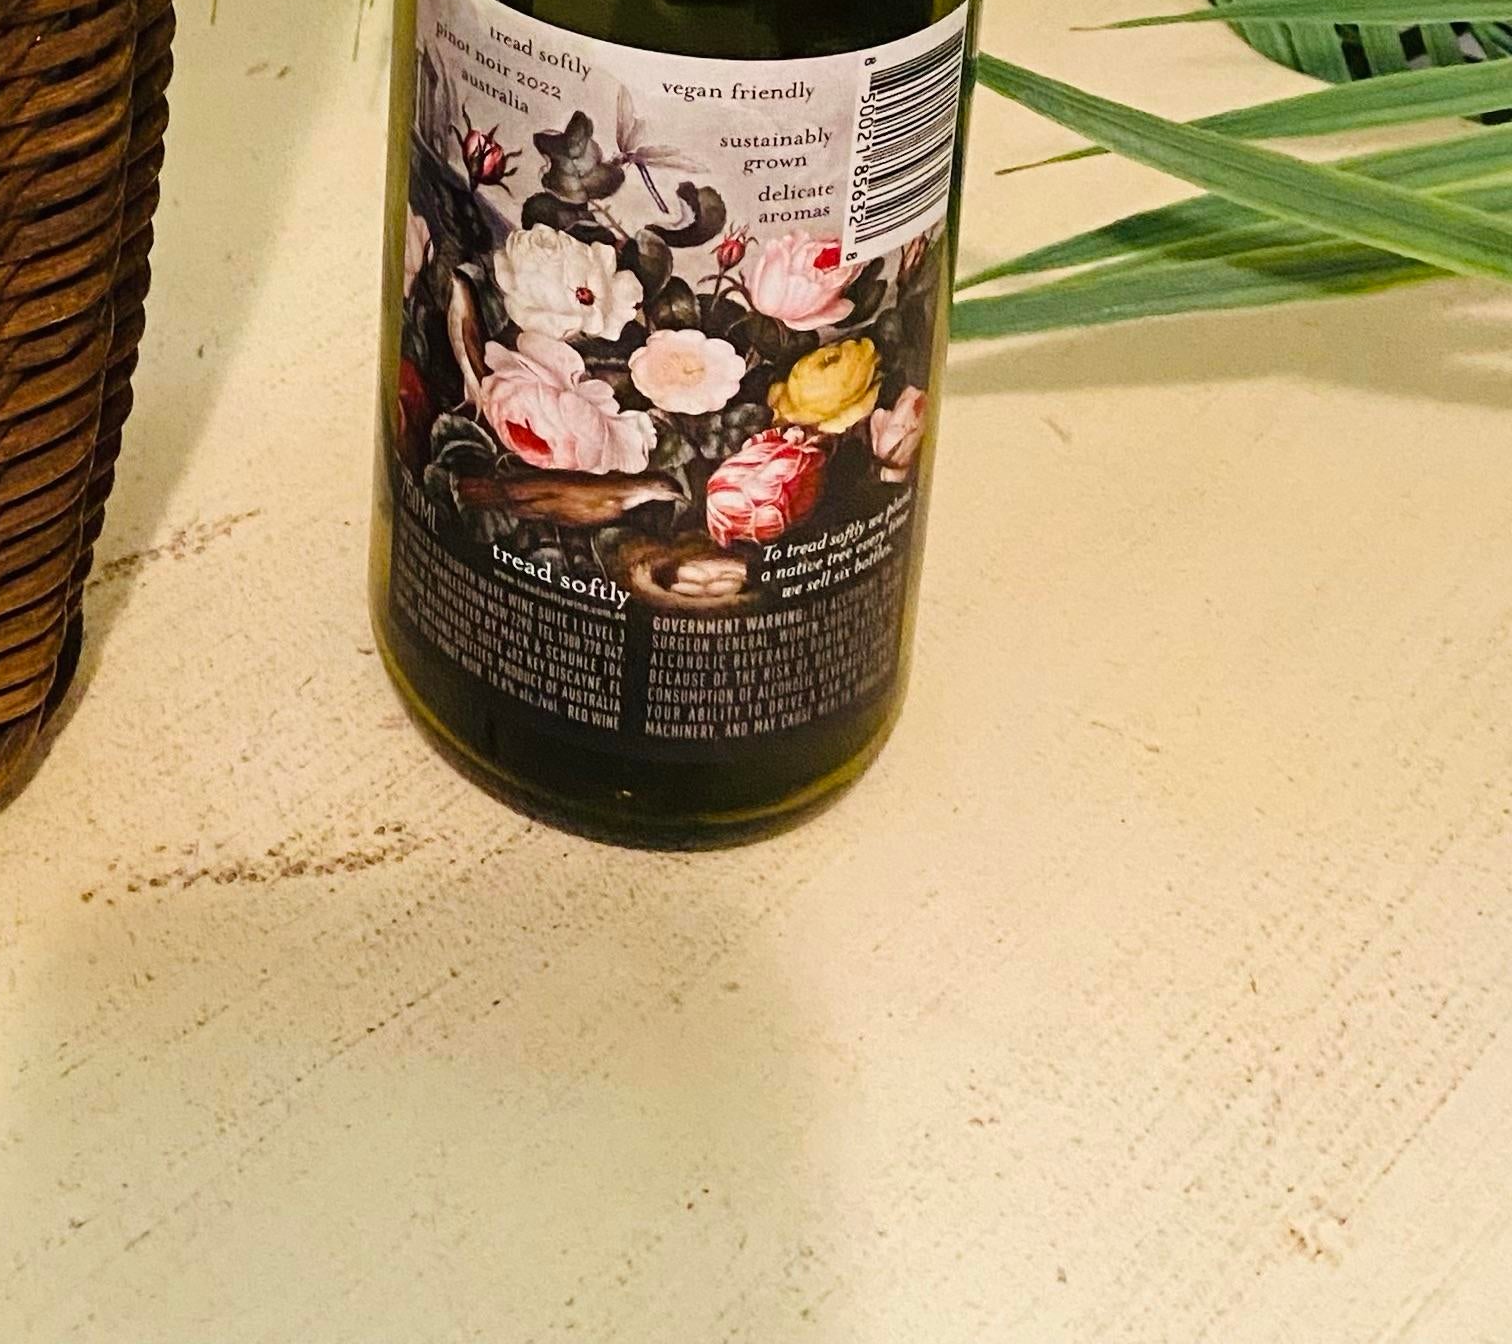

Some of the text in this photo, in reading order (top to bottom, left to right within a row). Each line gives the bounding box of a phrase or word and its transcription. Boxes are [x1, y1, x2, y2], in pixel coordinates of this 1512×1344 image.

[435, 21, 562, 100] pinot noir 2022
[490, 26, 592, 81] tread softly
[864, 57, 877, 67] 8
[461, 69, 529, 114] australia
[662, 81, 816, 104] vegan friendly
[719, 127, 833, 149] sustainably
[855, 92, 876, 154] 50021
[742, 154, 807, 177] grown
[758, 183, 835, 203] delicate
[849, 165, 870, 227] 85632
[758, 205, 831, 224] aromas
[761, 570, 771, 582] a
[776, 558, 823, 580] native
[827, 547, 853, 567] tree
[856, 529, 886, 554] every
[762, 543, 782, 562] To
[786, 532, 828, 558] tread
[829, 519, 866, 548] softly
[492, 543, 631, 610] tread softly
[781, 583, 803, 598] we
[806, 569, 831, 593] sell
[833, 565, 852, 583] six
[485, 615, 497, 632] BY
[501, 623, 529, 649] MACK
[508, 593, 534, 617] WINE
[538, 606, 568, 629] SUITE
[582, 620, 613, 641] LEVEL
[538, 621, 553, 642] TEL
[653, 615, 741, 634] GOVERNMENT
[746, 609, 808, 632] WARNING:
[652, 633, 710, 653] SURGEON
[779, 620, 819, 644] WOMEN
[649, 650, 726, 670] ALCOHOLIC
[733, 641, 805, 669] BEVERAGES
[498, 658, 542, 689] PRODUCT
[546, 680, 557, 695] OF
[562, 686, 621, 713] AUSTRALIA
[527, 653, 545, 672] KEY
[610, 680, 622, 697] FL
[648, 687, 734, 704] CONSUMPTION
[739, 686, 752, 703] OF
[757, 672, 814, 699] ALCOHOLIC
[649, 668, 706, 688] BECAUSE
[713, 670, 728, 687] OF
[735, 669, 756, 686] THE
[764, 662, 790, 681] RISK
[568, 704, 588, 723] RED
[591, 711, 619, 731] WINE
[647, 703, 681, 721] YOUR
[688, 705, 741, 722] ABILITY
[748, 702, 762, 719] TO
[769, 693, 803, 714] DRIVE
[725, 720, 748, 738] AND
[753, 716, 776, 734] MAY
